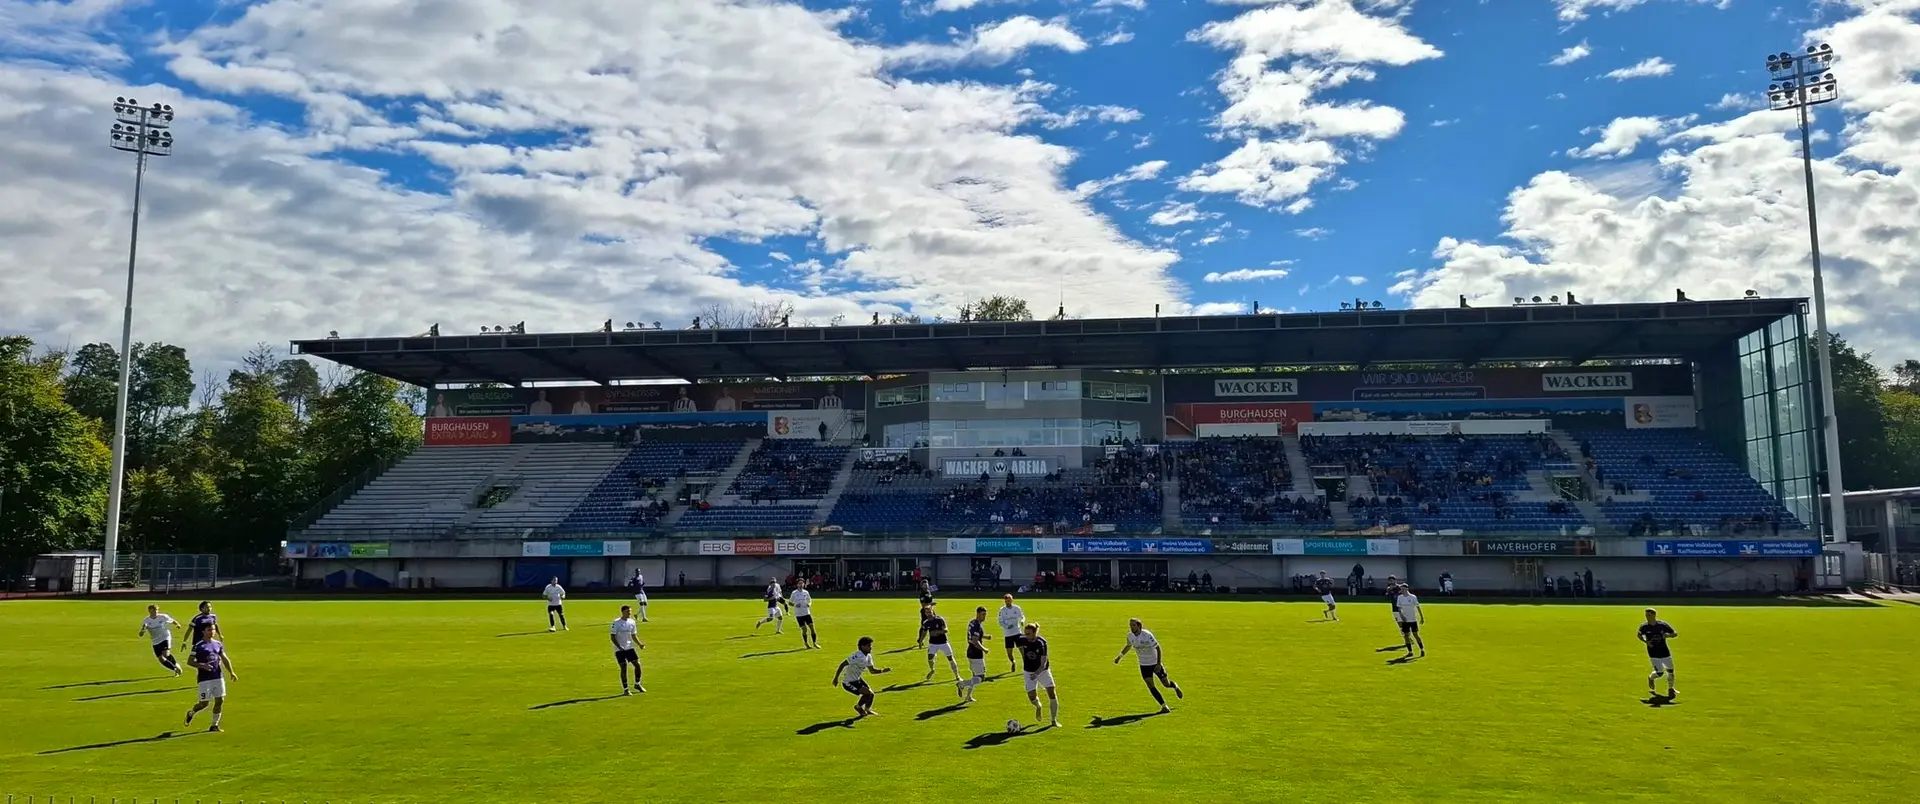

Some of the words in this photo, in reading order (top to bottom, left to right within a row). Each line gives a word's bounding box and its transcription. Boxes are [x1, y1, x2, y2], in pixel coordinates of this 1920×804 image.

[1390, 372, 1418, 384] SIND
[1422, 371, 1474, 383] WACKER
[1545, 375, 1628, 388] WACKER
[1218, 382, 1293, 393] WACKER
[1220, 408, 1287, 418] BURGHAUSEN
[432, 422, 489, 431] BURGHAUSEN
[945, 460, 990, 475] WACKER
[1011, 460, 1047, 474] ARENA
[702, 542, 731, 552] EBG
[778, 542, 806, 551] EBG
[1487, 542, 1557, 551] MAYERHOFER
